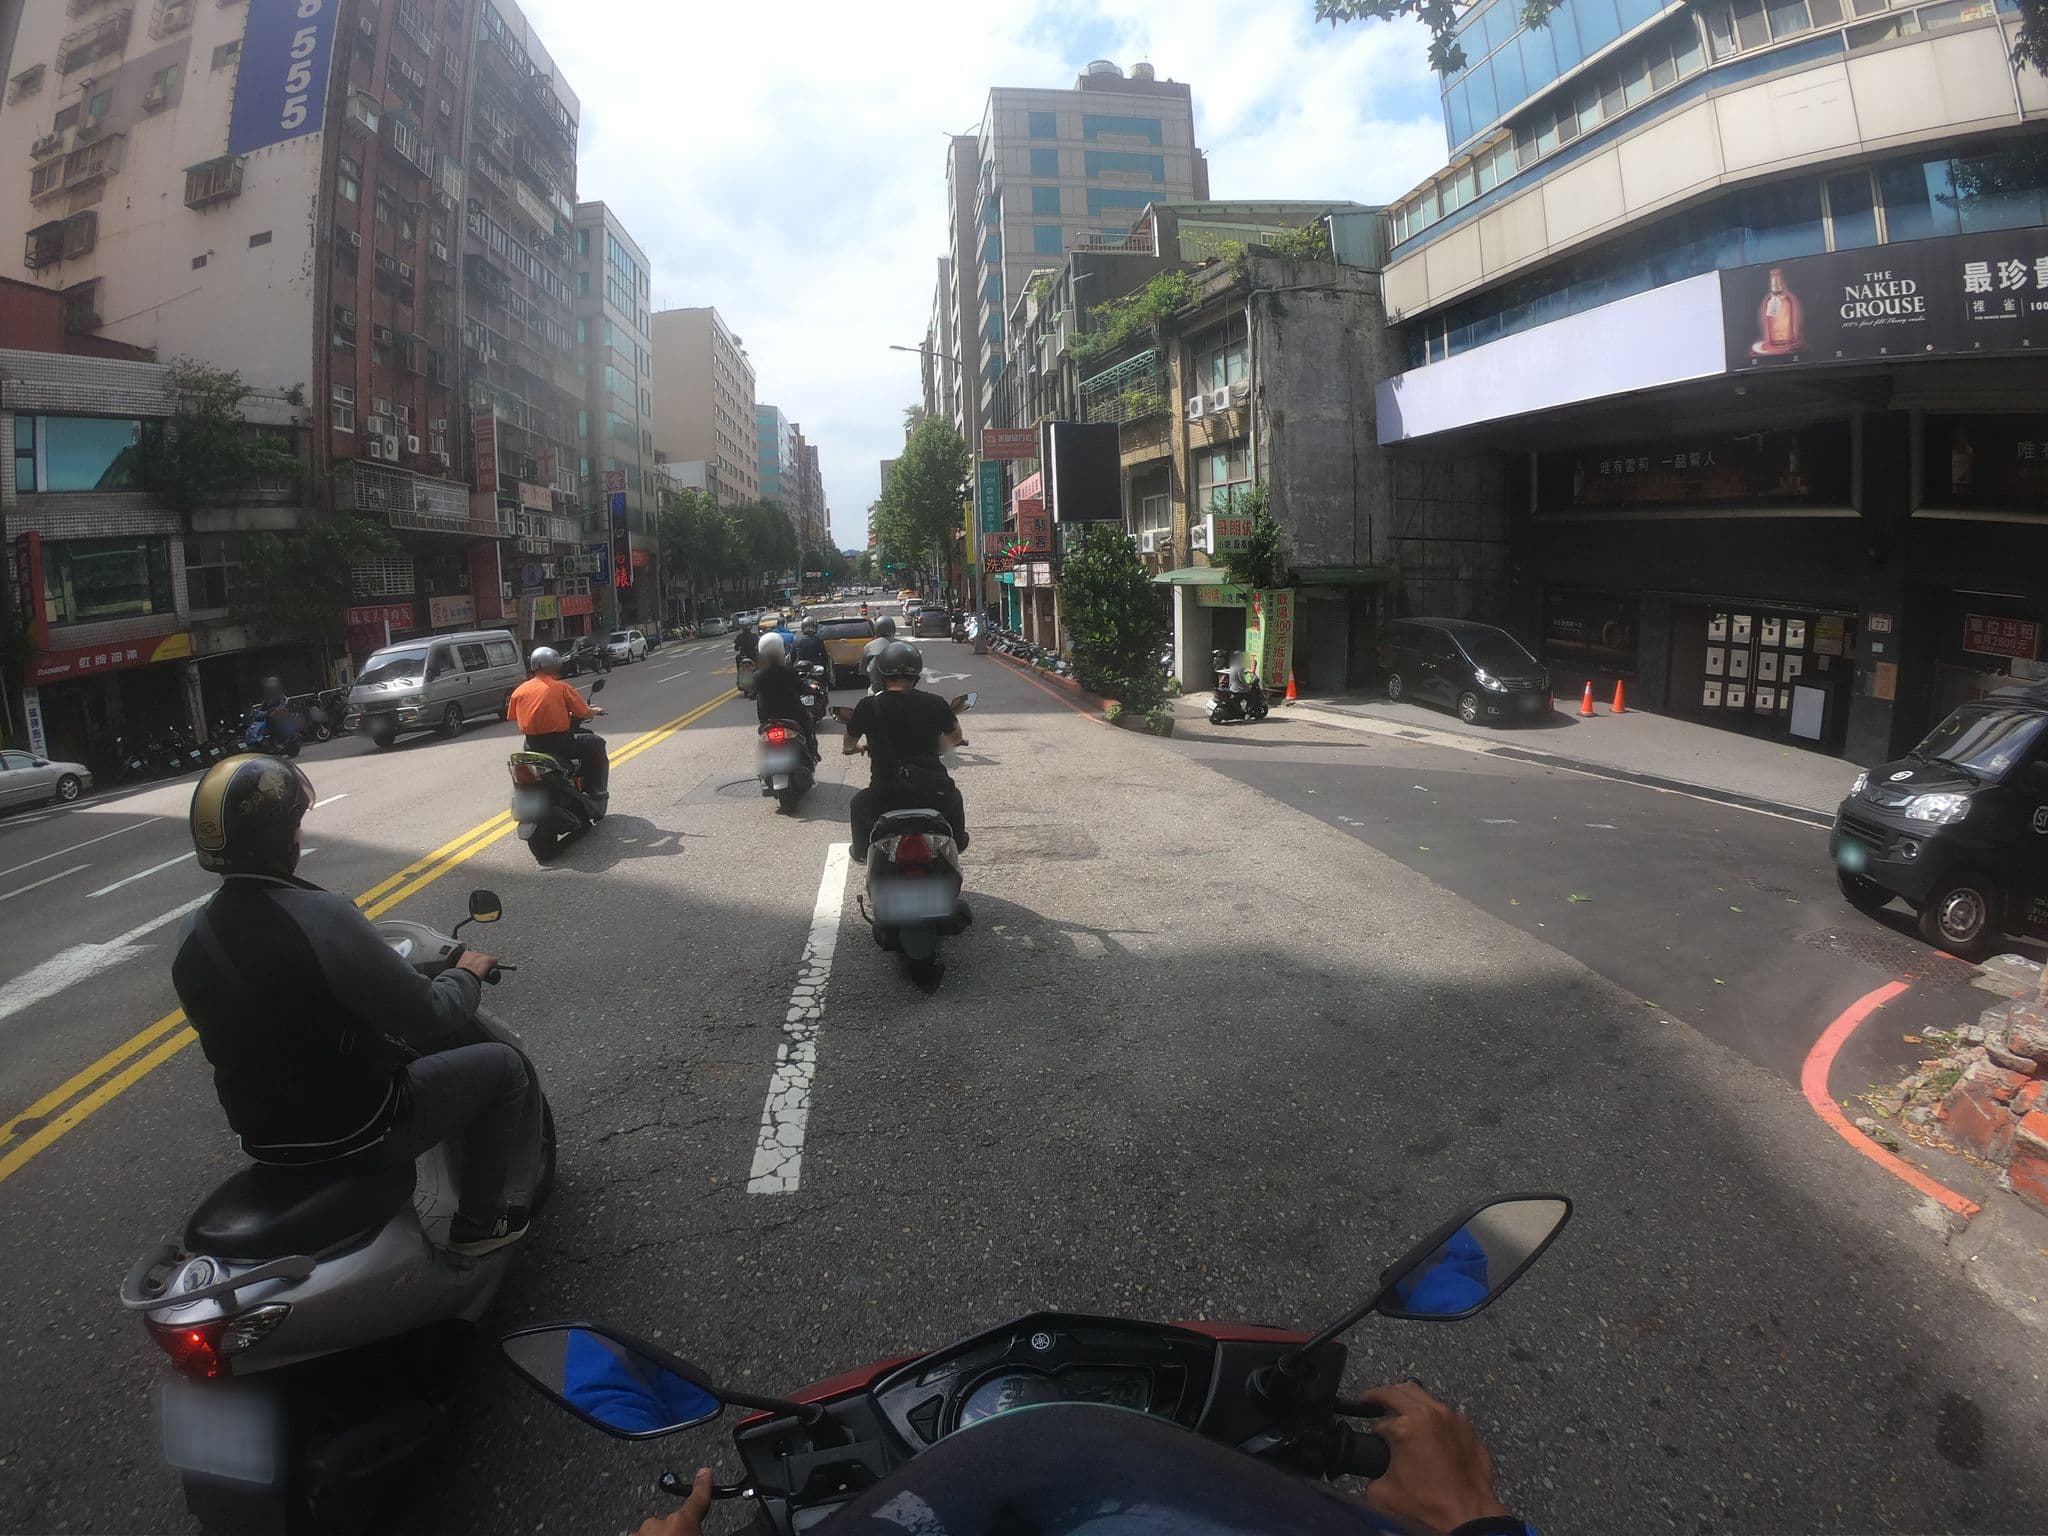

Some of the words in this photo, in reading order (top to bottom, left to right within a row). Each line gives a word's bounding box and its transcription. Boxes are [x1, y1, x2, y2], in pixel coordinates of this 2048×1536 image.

[1864, 270, 1893, 282] THE
[1845, 279, 1916, 301] NAKED
[1840, 296, 1926, 319] GROUSE
[1874, 620, 1886, 629] 77
